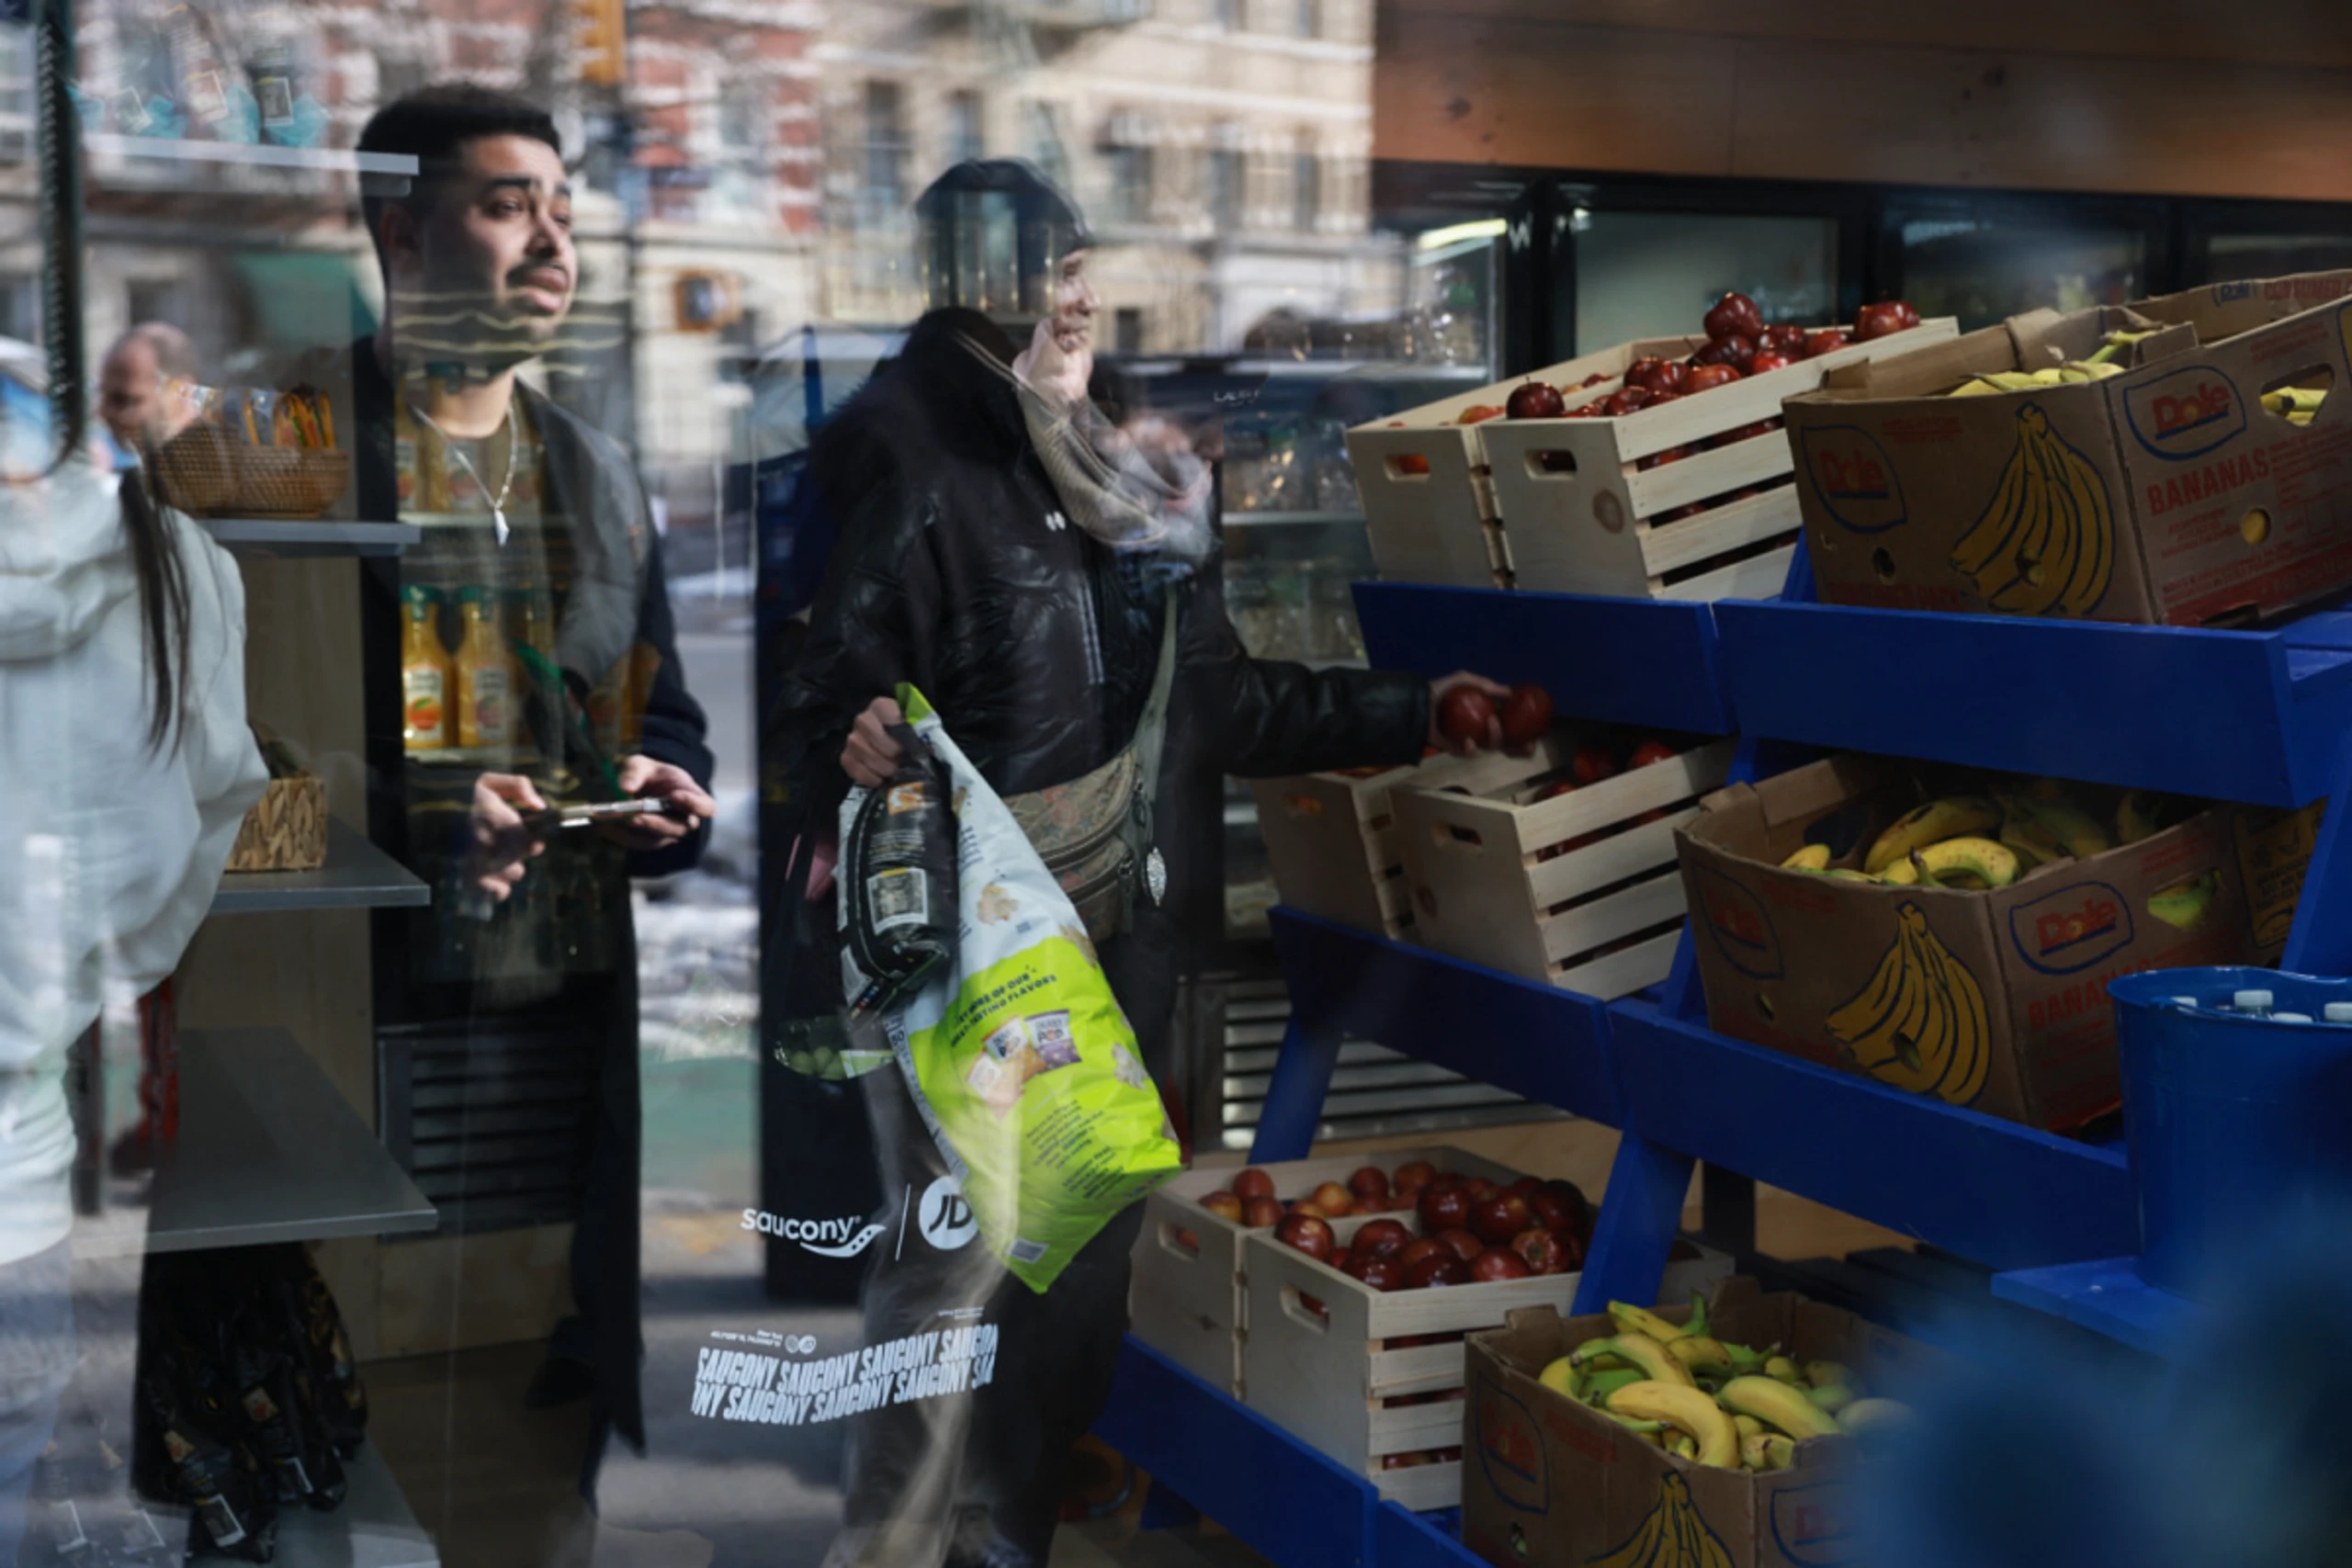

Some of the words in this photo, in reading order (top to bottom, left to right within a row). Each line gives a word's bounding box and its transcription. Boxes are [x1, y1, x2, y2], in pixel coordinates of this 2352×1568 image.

[2152, 380, 2233, 434] Dole
[1819, 448, 1887, 493] Dole
[2146, 447, 2270, 517] BANANAS
[2035, 897, 2118, 951] Dole
[1007, 972, 1030, 990] OUR
[2029, 957, 2151, 1032] BANAN
[741, 1207, 854, 1243] saucony
[928, 1192, 974, 1233] JD
[695, 1346, 780, 1391] SAUCONY
[776, 1350, 860, 1395] SAUCONY
[859, 1331, 940, 1381] SAUCONY
[723, 1385, 812, 1425] SAUCONY
[809, 1373, 895, 1423] SAUCONY
[894, 1359, 972, 1404] SAUCONY
